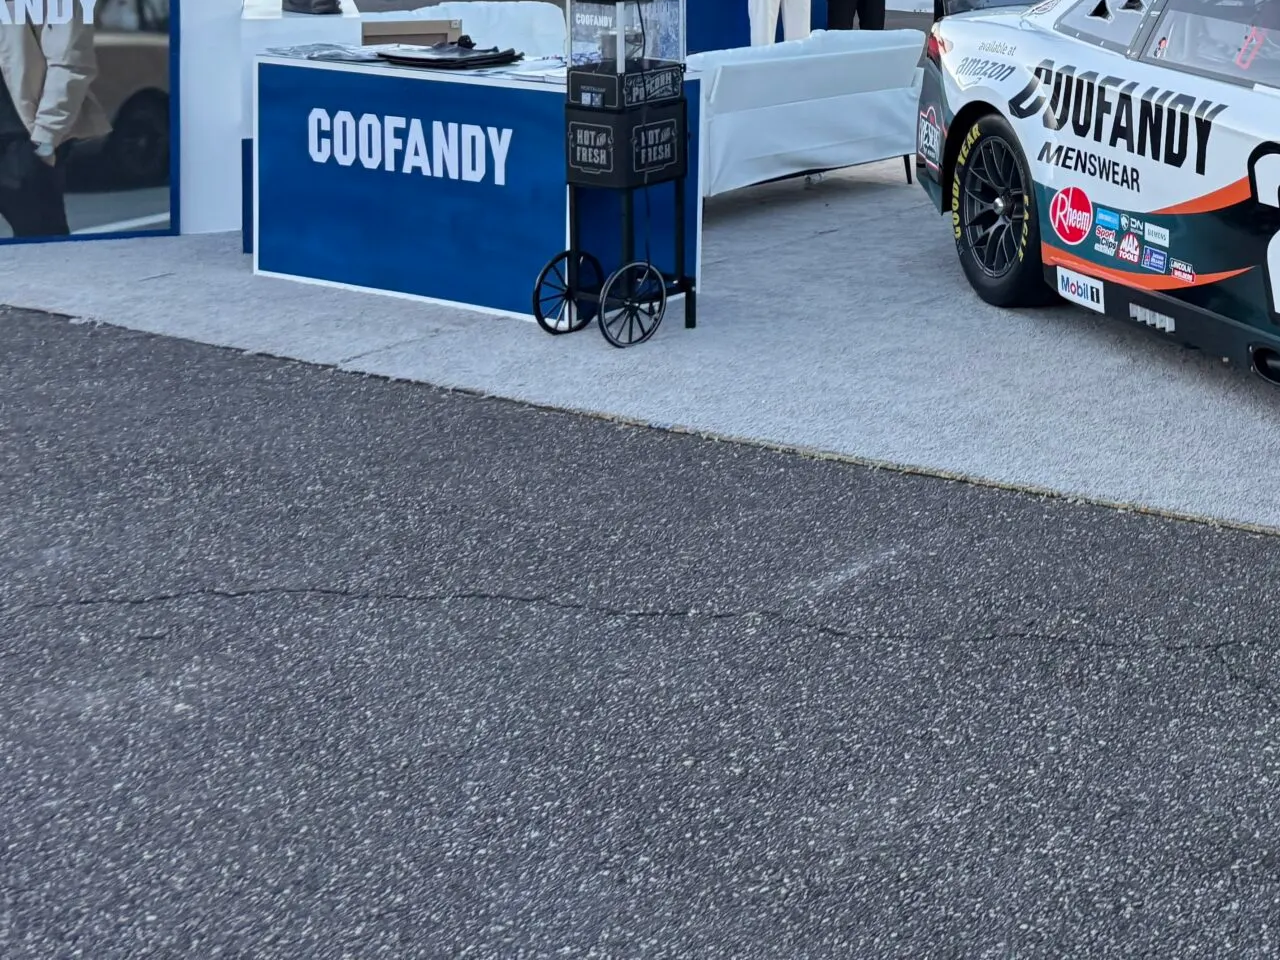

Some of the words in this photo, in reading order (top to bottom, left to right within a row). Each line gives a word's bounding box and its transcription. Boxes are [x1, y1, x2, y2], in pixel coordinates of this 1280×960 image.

[575, 13, 613, 28] COOFANDY
[978, 41, 1008, 55] available
[1008, 45, 1017, 56] at
[956, 56, 1017, 82] amazon
[1007, 58, 1229, 176] COOFANDY
[576, 129, 597, 146] HOT
[308, 107, 513, 186] COOFANDY
[576, 147, 607, 165] FRESH
[1037, 141, 1141, 193] MENSWEAR
[1055, 187, 1090, 234] Rheem
[1130, 218, 1144, 230] DN
[1096, 226, 1116, 240] Sport
[1100, 238, 1117, 250] Clips
[1121, 233, 1140, 252] MAC
[1118, 249, 1139, 263] TOOLS
[1170, 258, 1192, 273] LINCOLN
[1060, 274, 1089, 301] Mobil
[1090, 285, 1101, 304] 1
